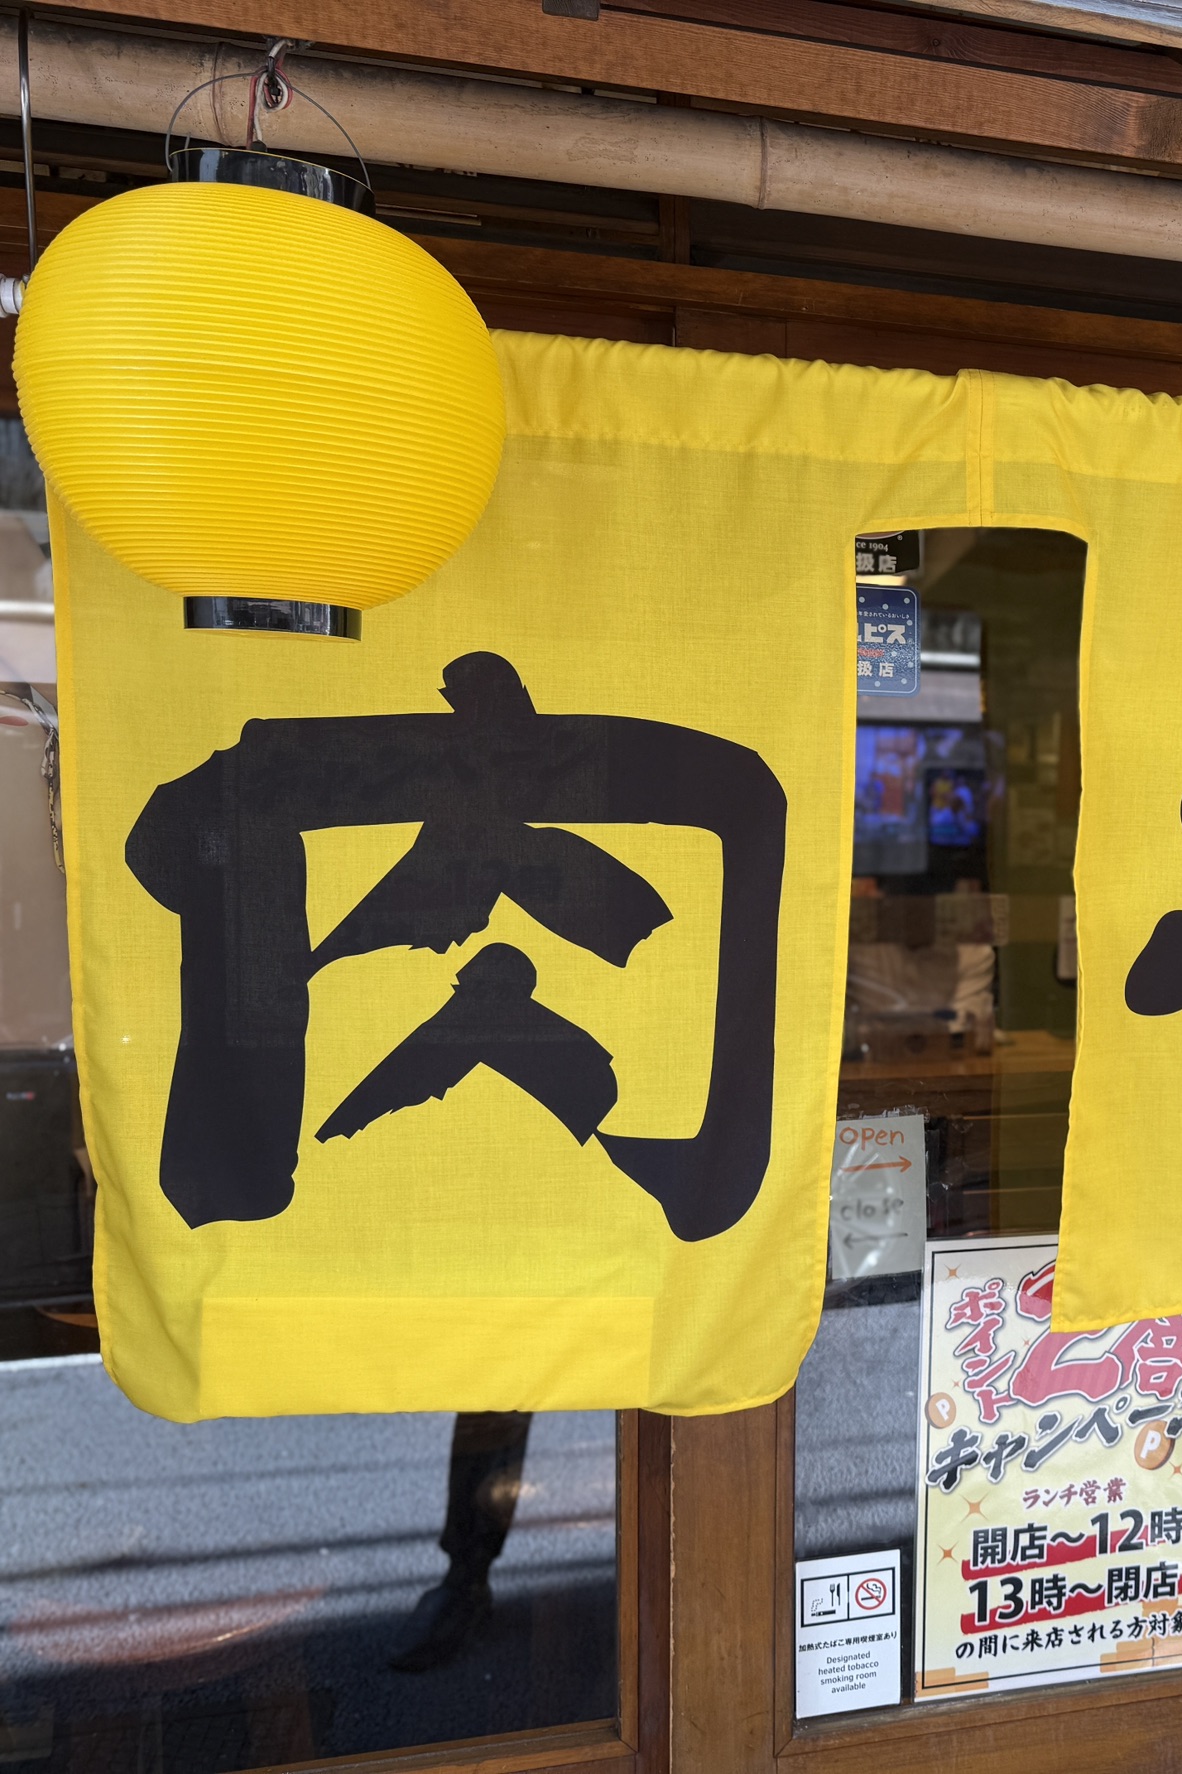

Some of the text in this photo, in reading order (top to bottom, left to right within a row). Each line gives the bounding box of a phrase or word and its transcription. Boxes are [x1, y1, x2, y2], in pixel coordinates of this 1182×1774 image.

[868, 542, 889, 552] 1904
[858, 623, 907, 645] ピス
[947, 1279, 1021, 1422] ポイント
[1022, 1477, 1126, 1509] ランチ営業
[798, 1630, 898, 1652] 加熱式たばこ専用喫煙室あり
[826, 1651, 871, 1664] Designated
[818, 1661, 879, 1676] heated tobacco
[820, 1671, 877, 1685] smoking room
[831, 1682, 866, 1693] available
